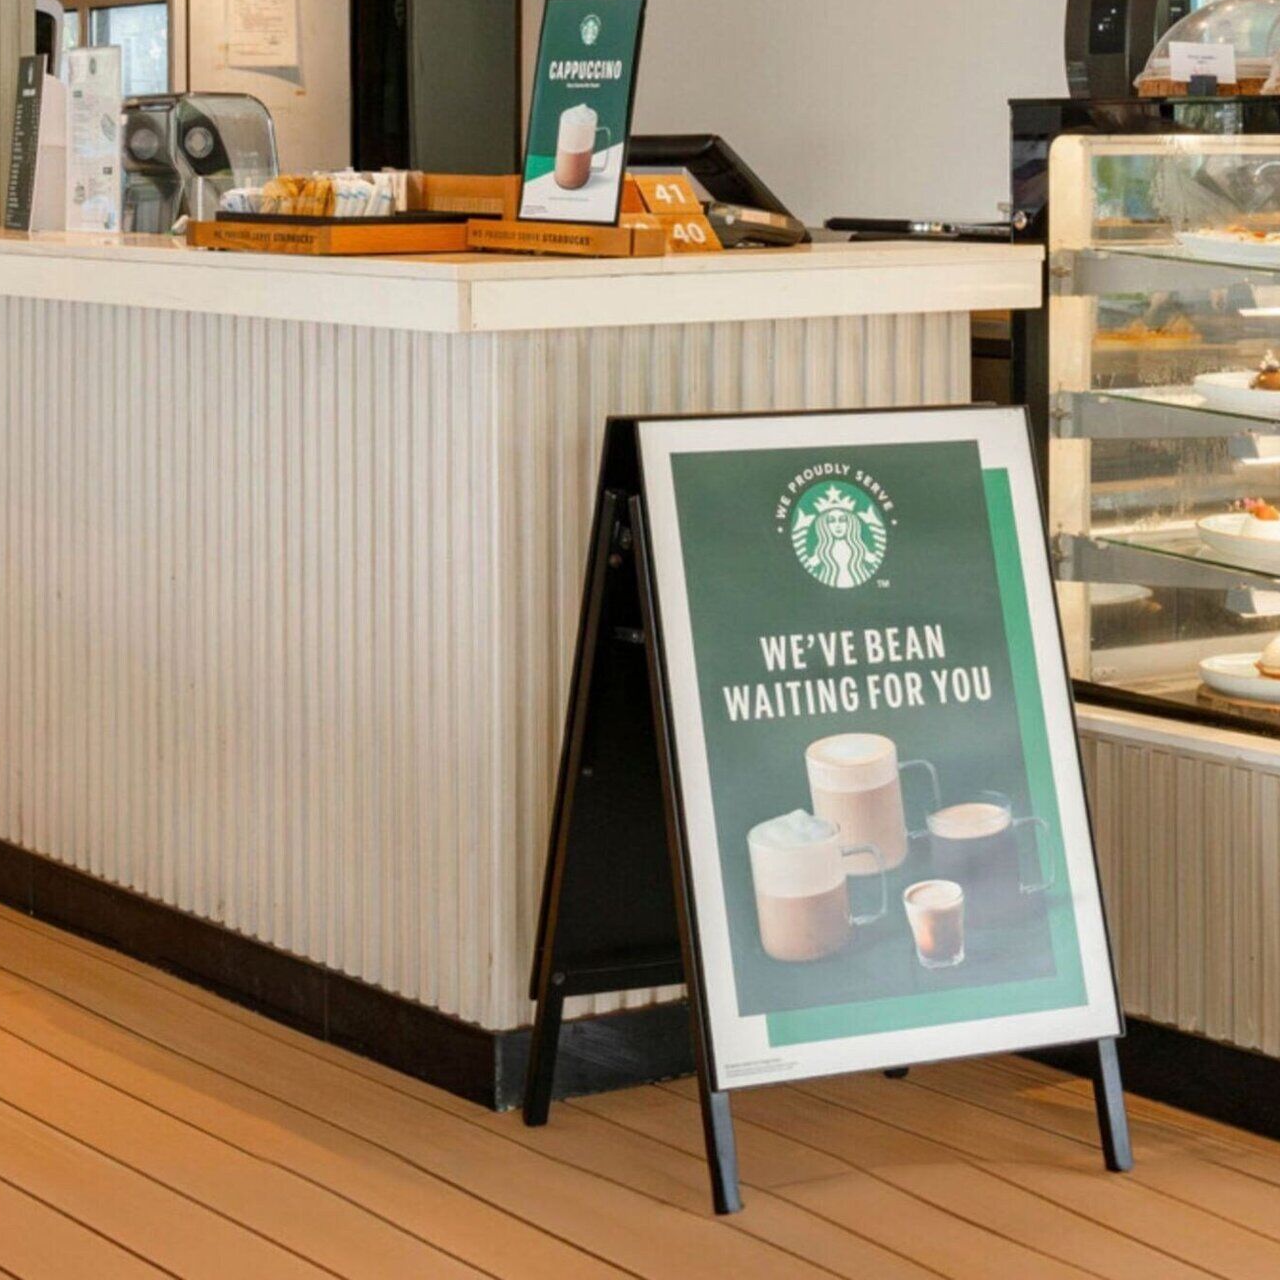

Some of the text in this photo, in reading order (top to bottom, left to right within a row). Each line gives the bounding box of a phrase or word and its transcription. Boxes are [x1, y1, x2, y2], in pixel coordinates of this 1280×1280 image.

[549, 60, 623, 81] CAPPUCCINO
[655, 183, 686, 205] 41
[673, 223, 706, 244] 40
[776, 463, 893, 518] WE PROUDLY SERVE
[760, 624, 946, 671] WE'VE BEAN
[723, 666, 992, 721] WAITING FOR YOU
